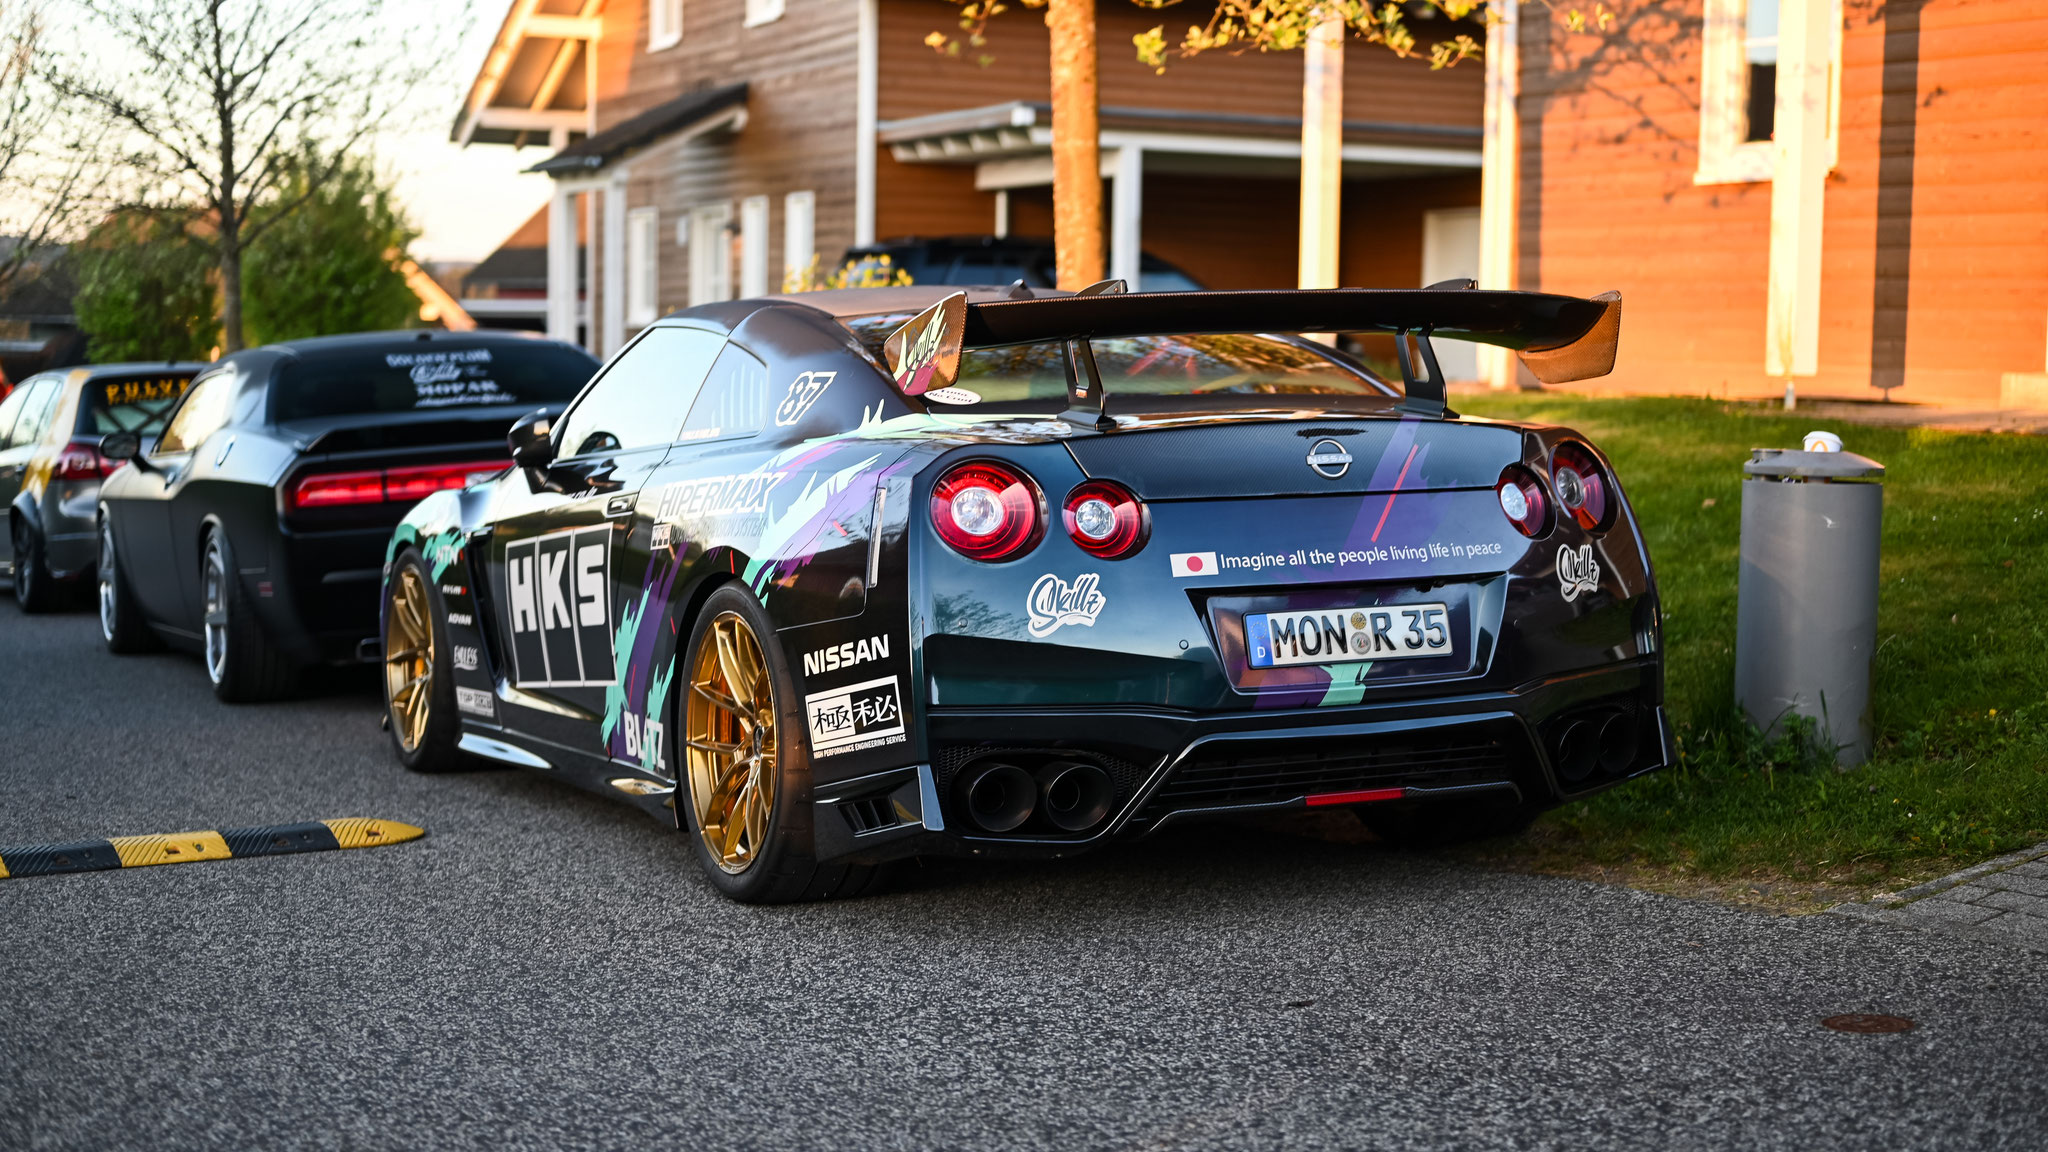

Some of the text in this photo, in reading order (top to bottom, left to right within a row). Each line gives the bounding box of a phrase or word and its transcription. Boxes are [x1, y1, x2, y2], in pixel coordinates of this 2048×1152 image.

[775, 371, 838, 427] 87
[1308, 454, 1352, 464] NISSAN
[655, 473, 785, 520] HIPERMAX
[1220, 542, 1502, 571] Imagine all the people living life in peace
[1556, 544, 1600, 602] Skillz
[509, 544, 605, 633] HKS
[1027, 573, 1107, 638] Skillz
[803, 633, 890, 677] NISSAN
[1257, 609, 1448, 658] D MON R 35
[812, 694, 898, 735] 極秘
[624, 710, 666, 770] BLITZ
[823, 743, 855, 757] PERFORMANCE
[854, 738, 886, 751] ENGINEERING
[885, 733, 907, 745] SERVICE
